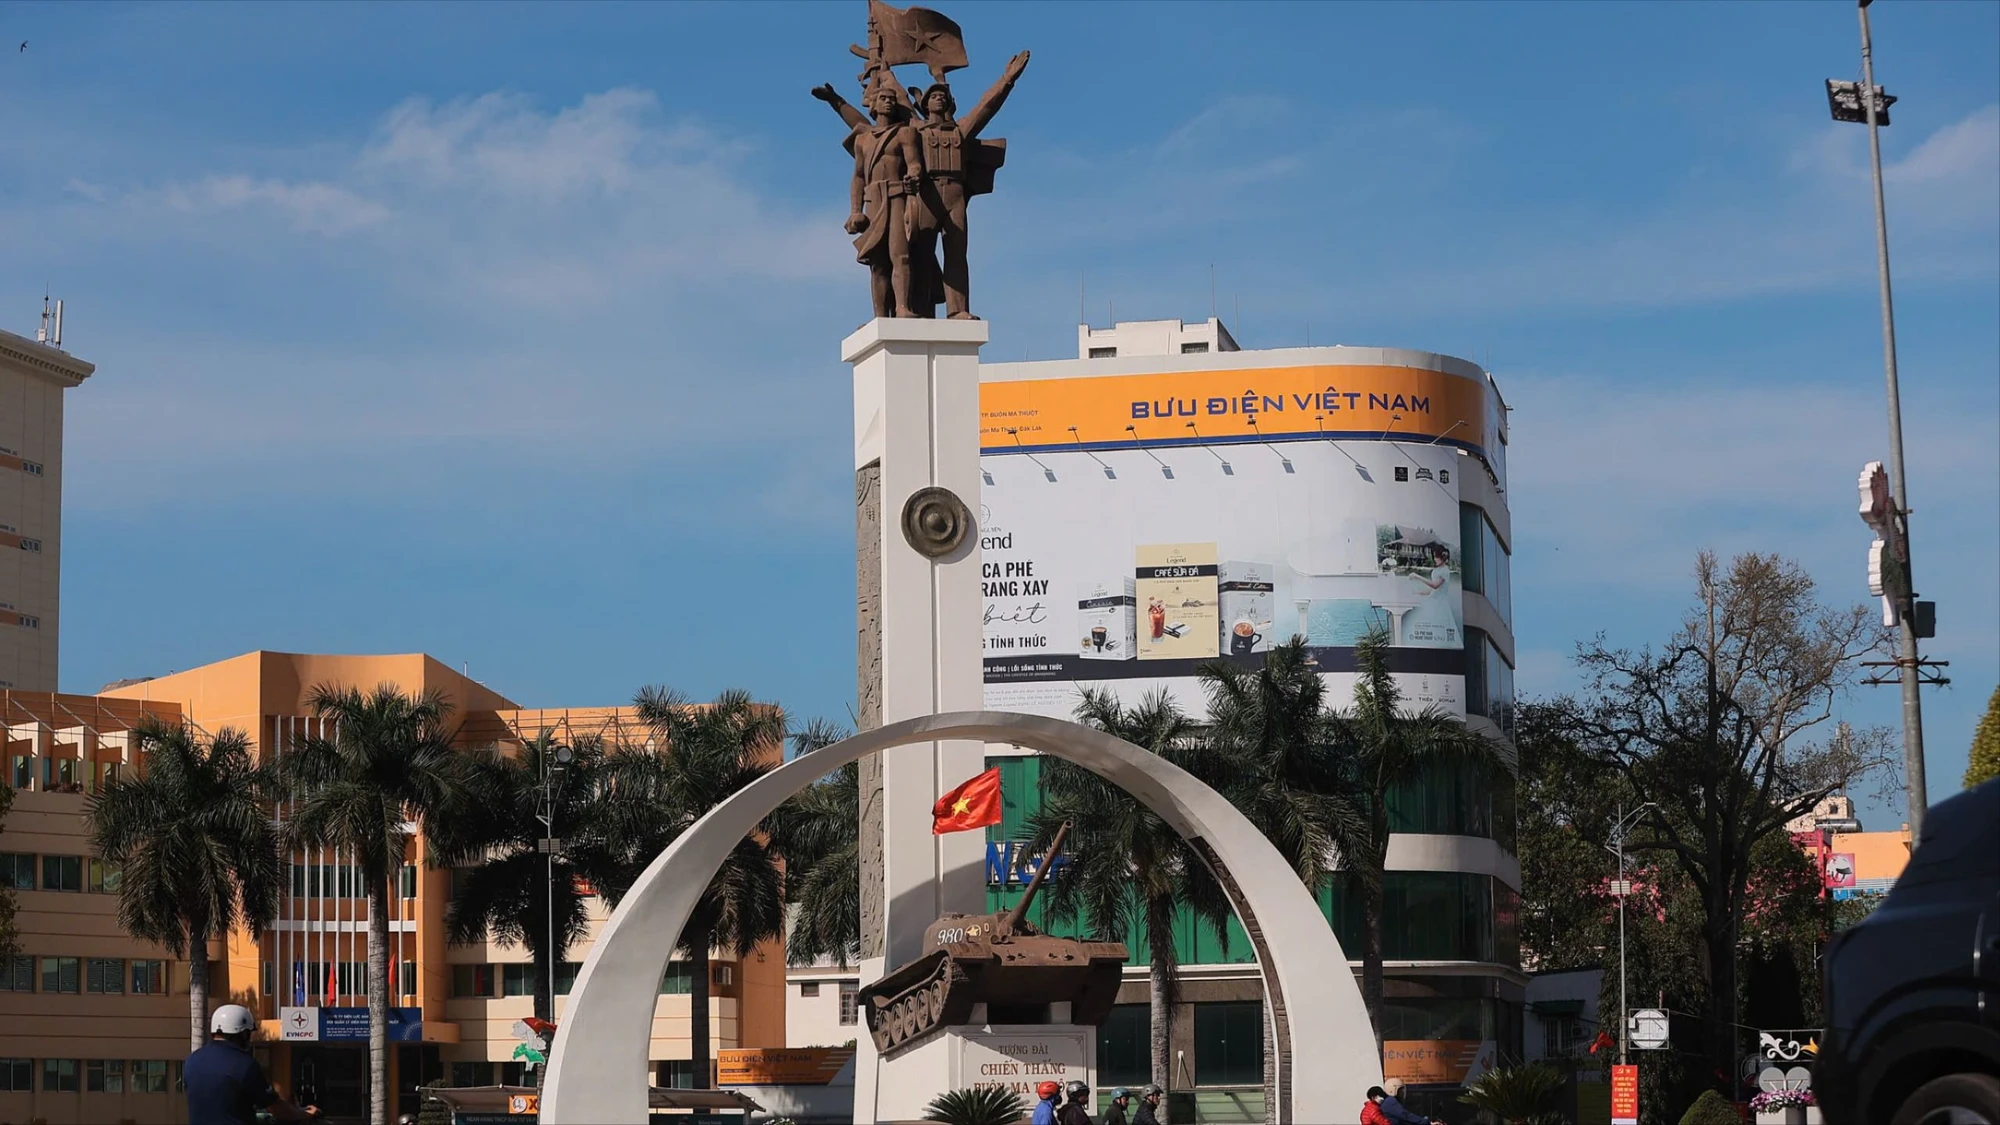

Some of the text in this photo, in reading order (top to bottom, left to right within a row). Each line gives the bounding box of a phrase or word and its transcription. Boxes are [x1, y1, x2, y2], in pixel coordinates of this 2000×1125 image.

[1131, 386, 1430, 419] BƯU ĐIỆN VIỆT NAM
[980, 532, 1012, 550] end
[1006, 559, 1034, 577] PHÊ
[1154, 567, 1172, 577] CAFÉ
[1023, 580, 1049, 596] XAY
[1019, 633, 1047, 648] THỨC
[937, 927, 963, 945] 980
[998, 1042, 1049, 1058] TƯỢNG ĐÀI
[1406, 1048, 1434, 1060] VIỆT
[720, 1054, 740, 1063] BƯU
[980, 1059, 1066, 1075] CHIẾN THẮNG
[1010, 1082, 1030, 1094] MA
